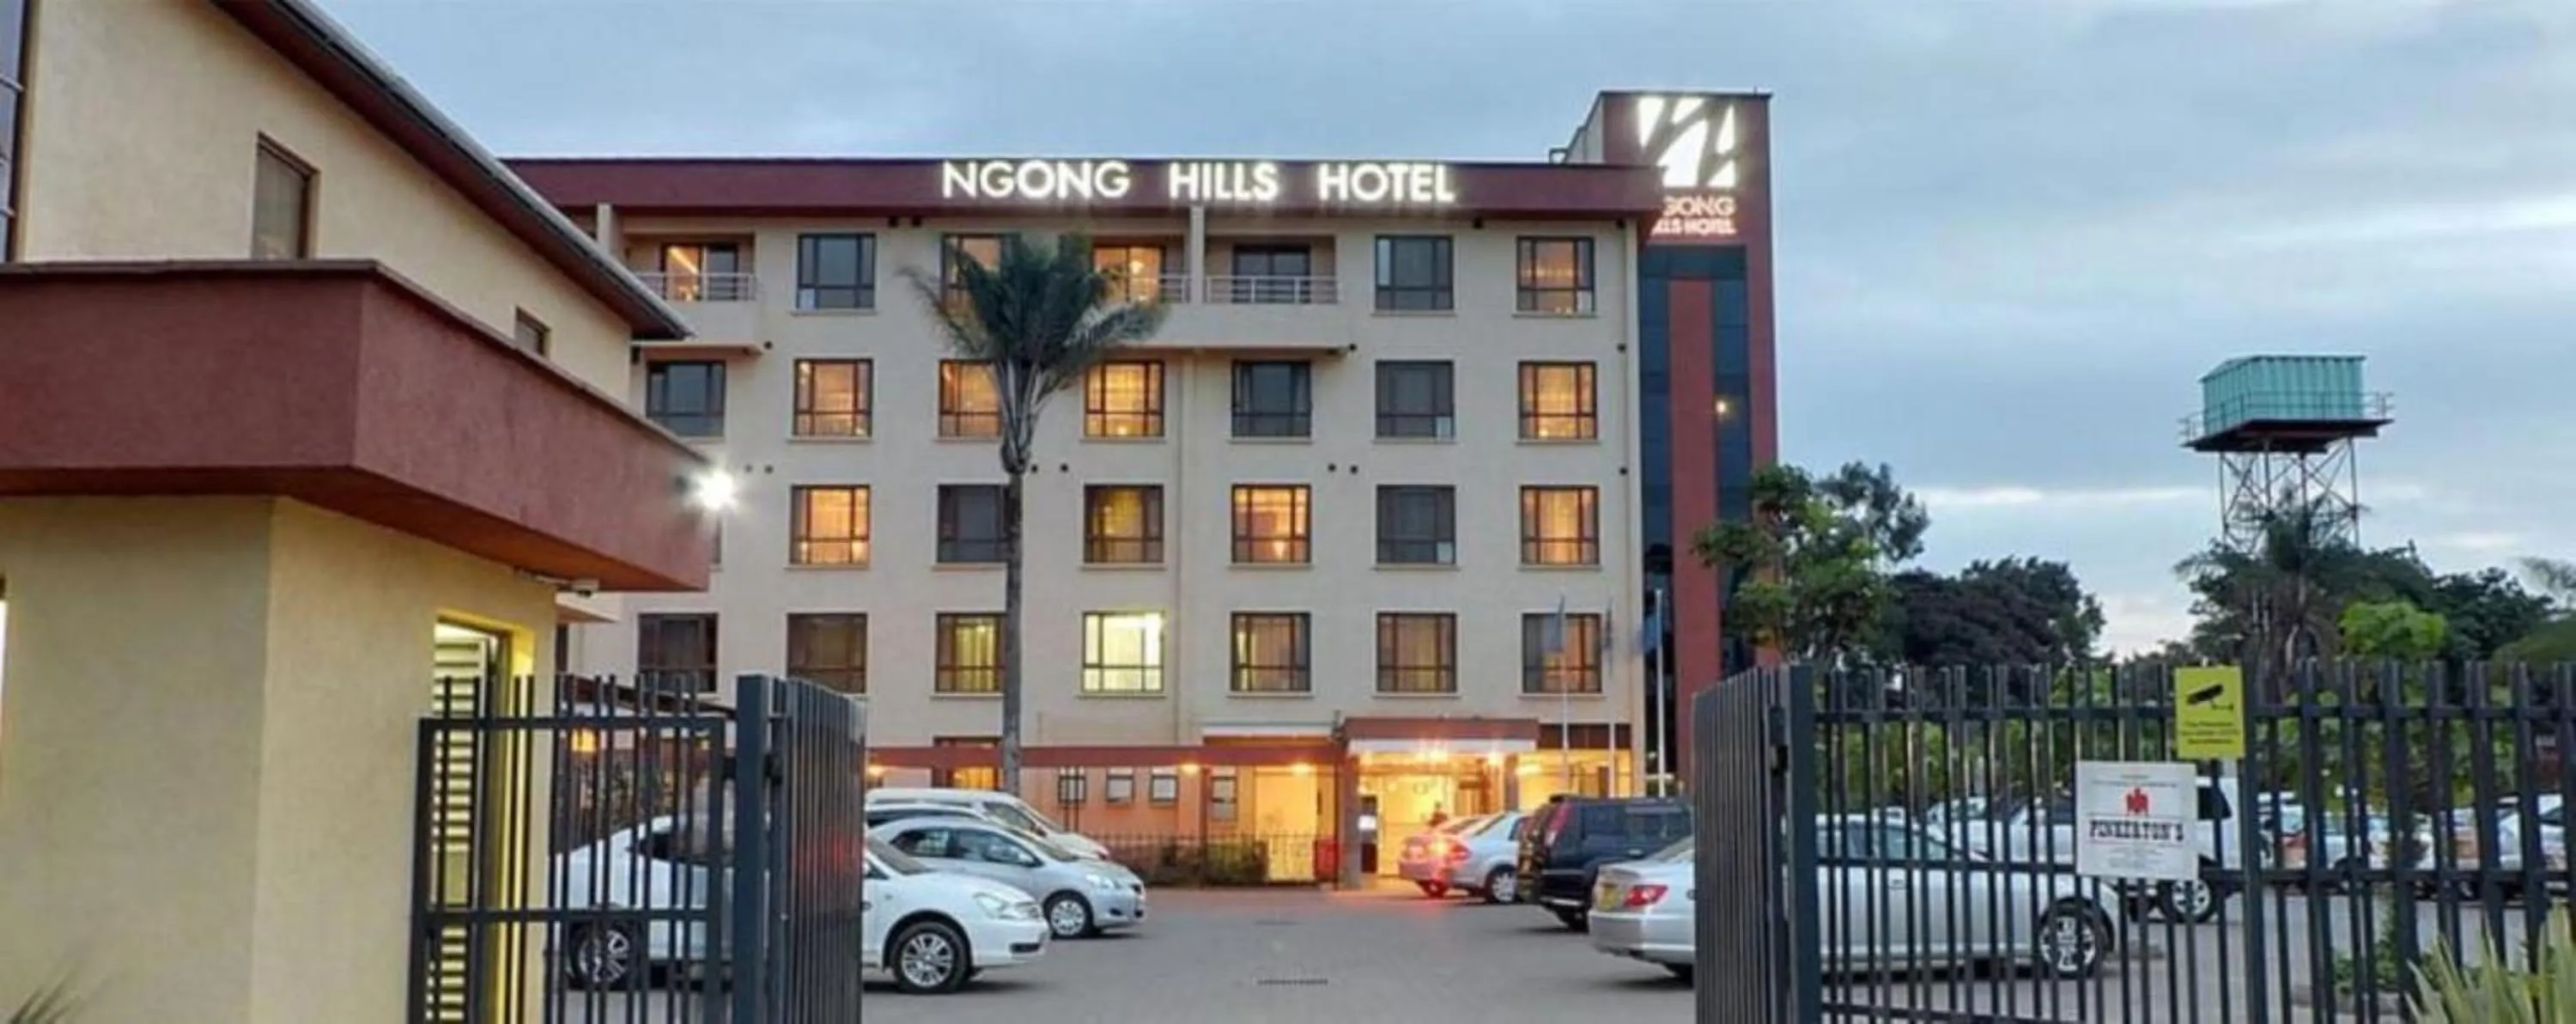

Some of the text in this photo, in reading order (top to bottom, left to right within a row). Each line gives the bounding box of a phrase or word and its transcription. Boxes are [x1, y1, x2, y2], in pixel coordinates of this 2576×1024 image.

[942, 160, 1454, 203] NGONG HILLS HOTEL
[1663, 195, 1736, 216] GONG
[1684, 217, 1736, 235] HOTEL
